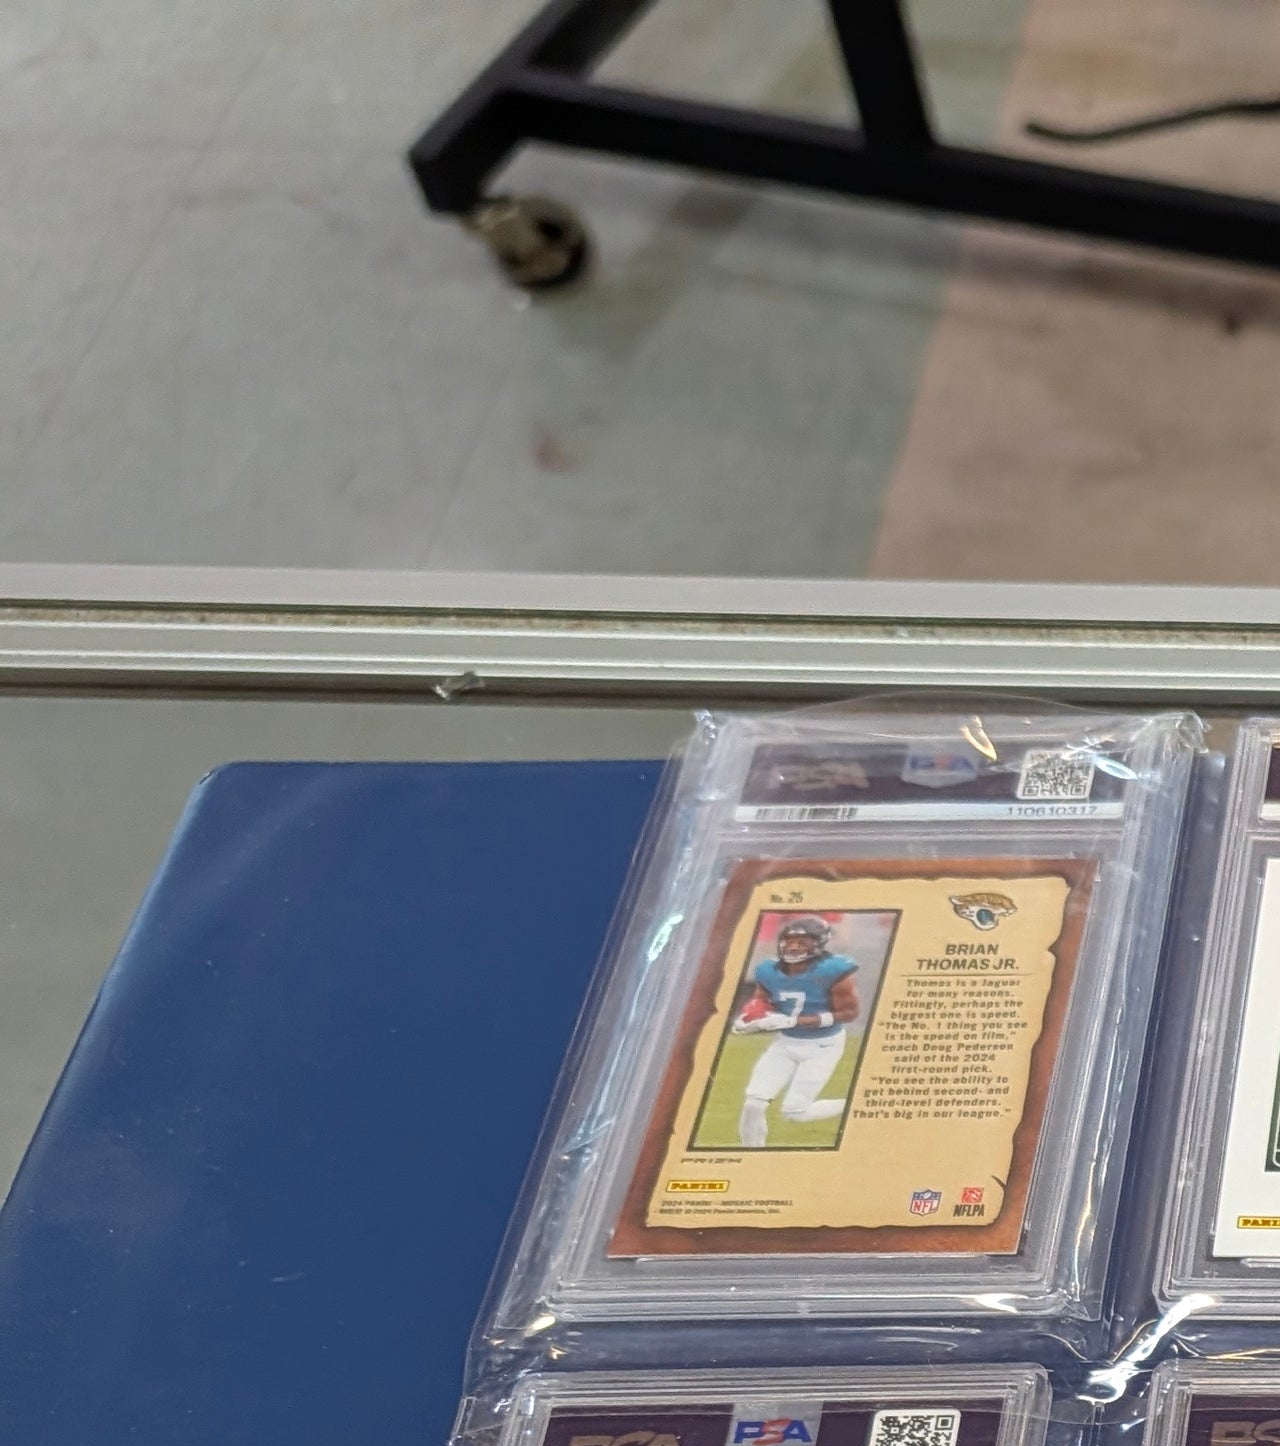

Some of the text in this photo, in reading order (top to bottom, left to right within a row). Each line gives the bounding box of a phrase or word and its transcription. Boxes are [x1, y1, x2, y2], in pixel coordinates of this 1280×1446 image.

[945, 944, 999, 956] BRIAN
[917, 958, 1020, 970] THOMAS JR.
[779, 991, 806, 1017] 7
[911, 1201, 937, 1214] NFL
[954, 1204, 985, 1217] NFLPA
